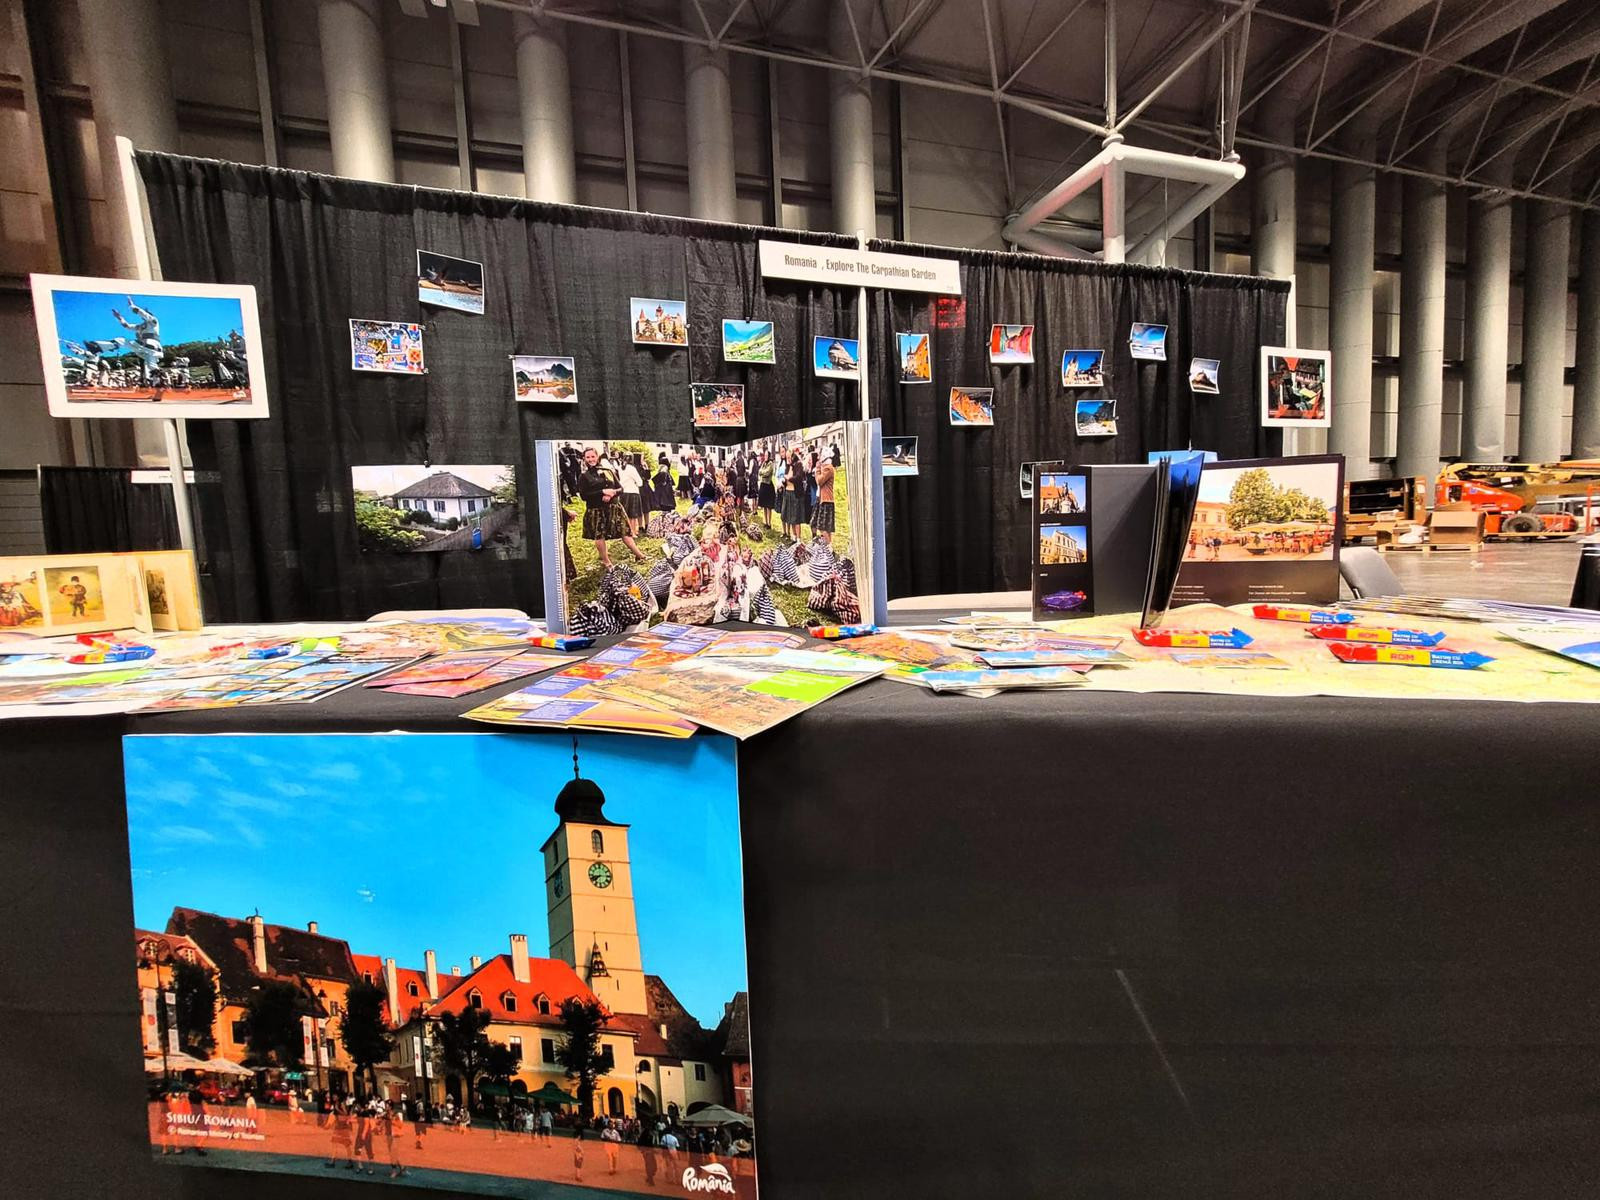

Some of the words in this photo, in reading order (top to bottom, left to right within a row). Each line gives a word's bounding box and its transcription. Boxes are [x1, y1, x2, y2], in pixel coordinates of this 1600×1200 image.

[784, 254, 817, 268] Romania
[826, 259, 854, 272] Explore
[856, 262, 869, 274] The
[871, 264, 910, 278] Carpathian
[911, 268, 937, 280] Garden
[1390, 653, 1415, 661] ROM
[204, 1115, 256, 1128] ROMANIA
[682, 1166, 736, 1194] România
